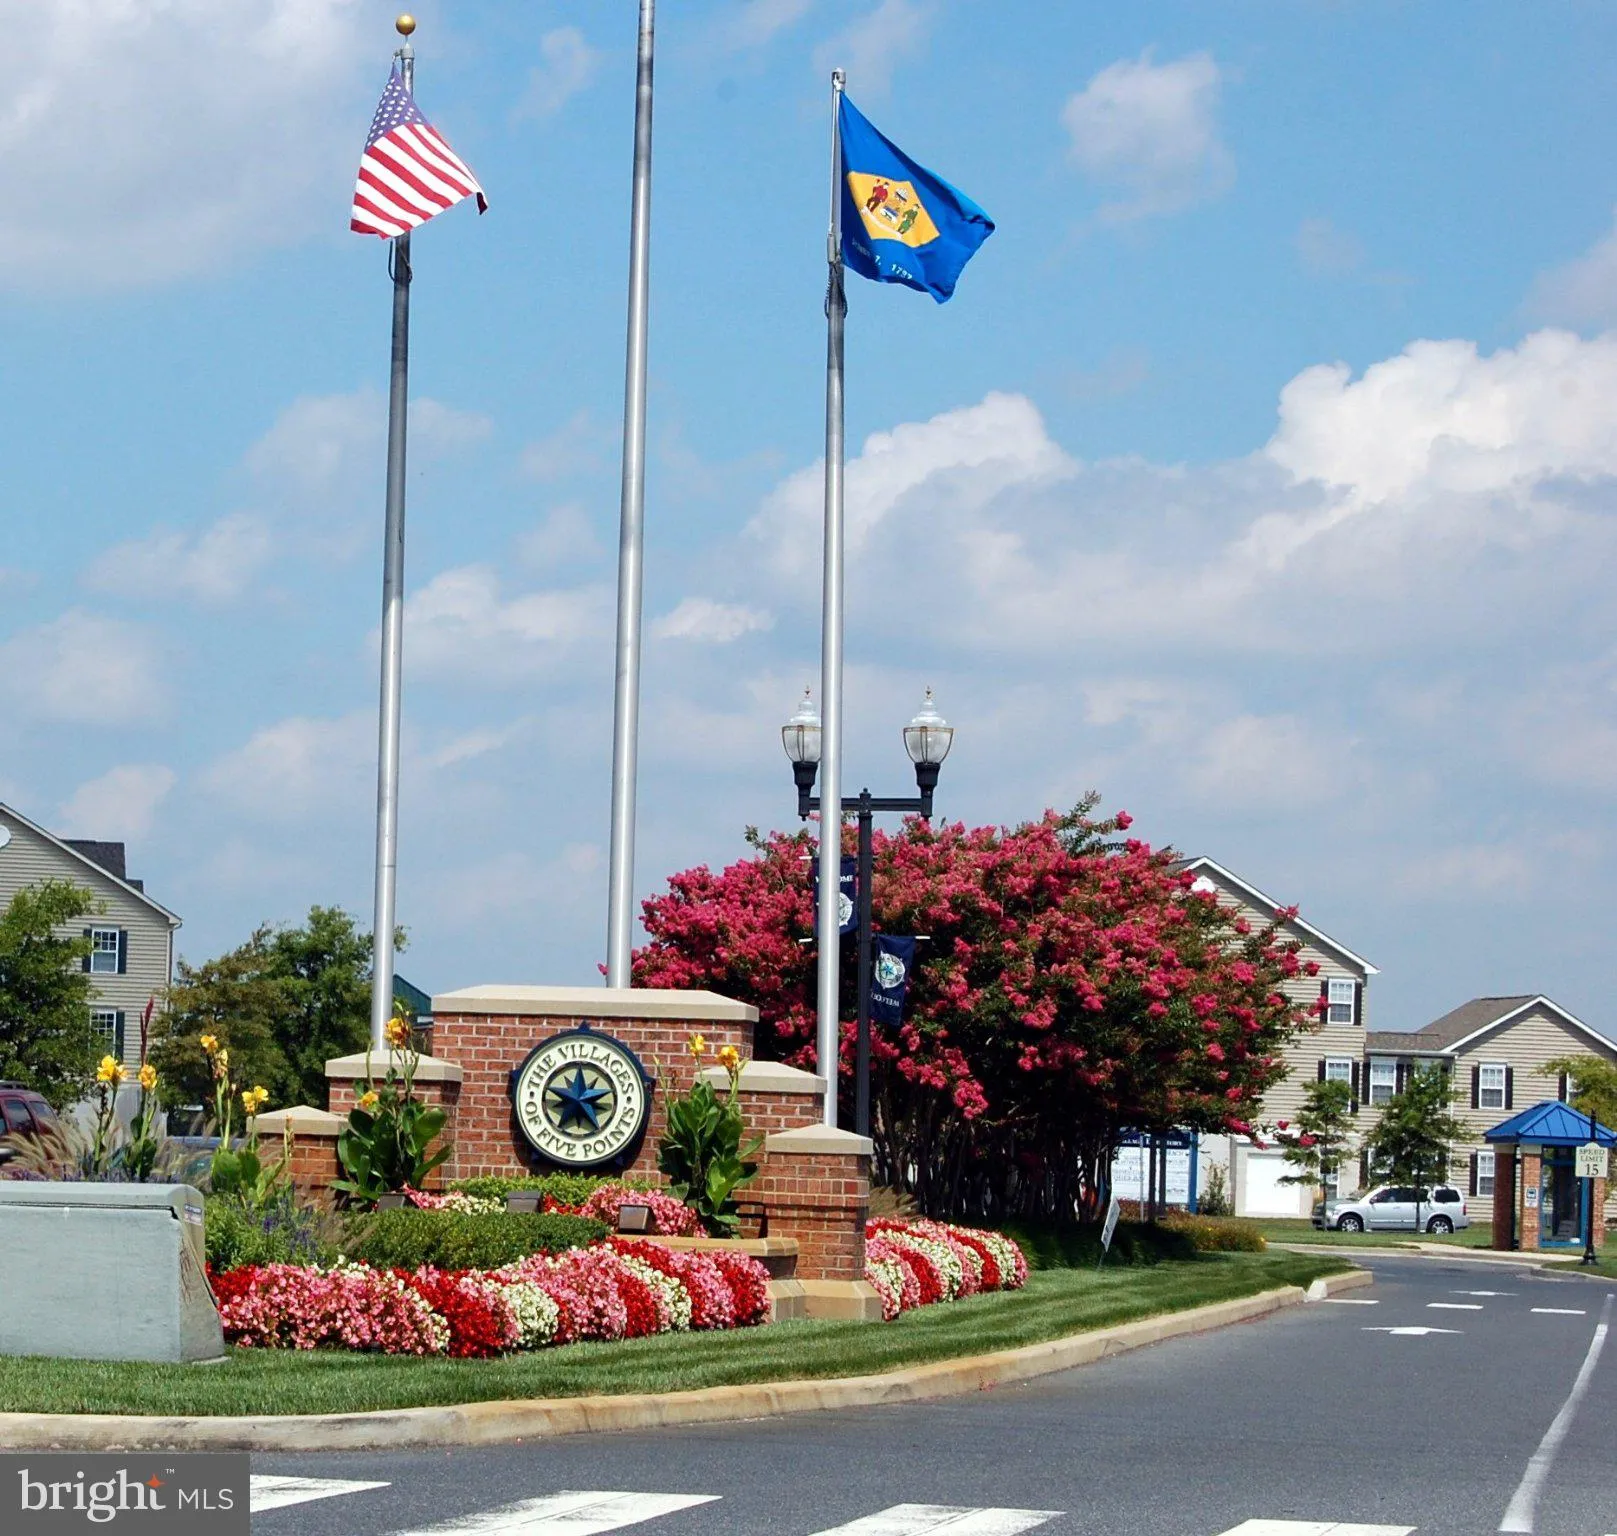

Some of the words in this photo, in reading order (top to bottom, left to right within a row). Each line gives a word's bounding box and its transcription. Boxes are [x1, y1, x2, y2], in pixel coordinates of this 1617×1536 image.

[527, 1054, 556, 1090] THE
[558, 1043, 635, 1095] VILLAGES
[524, 1101, 542, 1127] OF
[536, 1127, 577, 1158] FIVE
[582, 1106, 636, 1158] POINTS
[1585, 1163, 1599, 1176] 15
